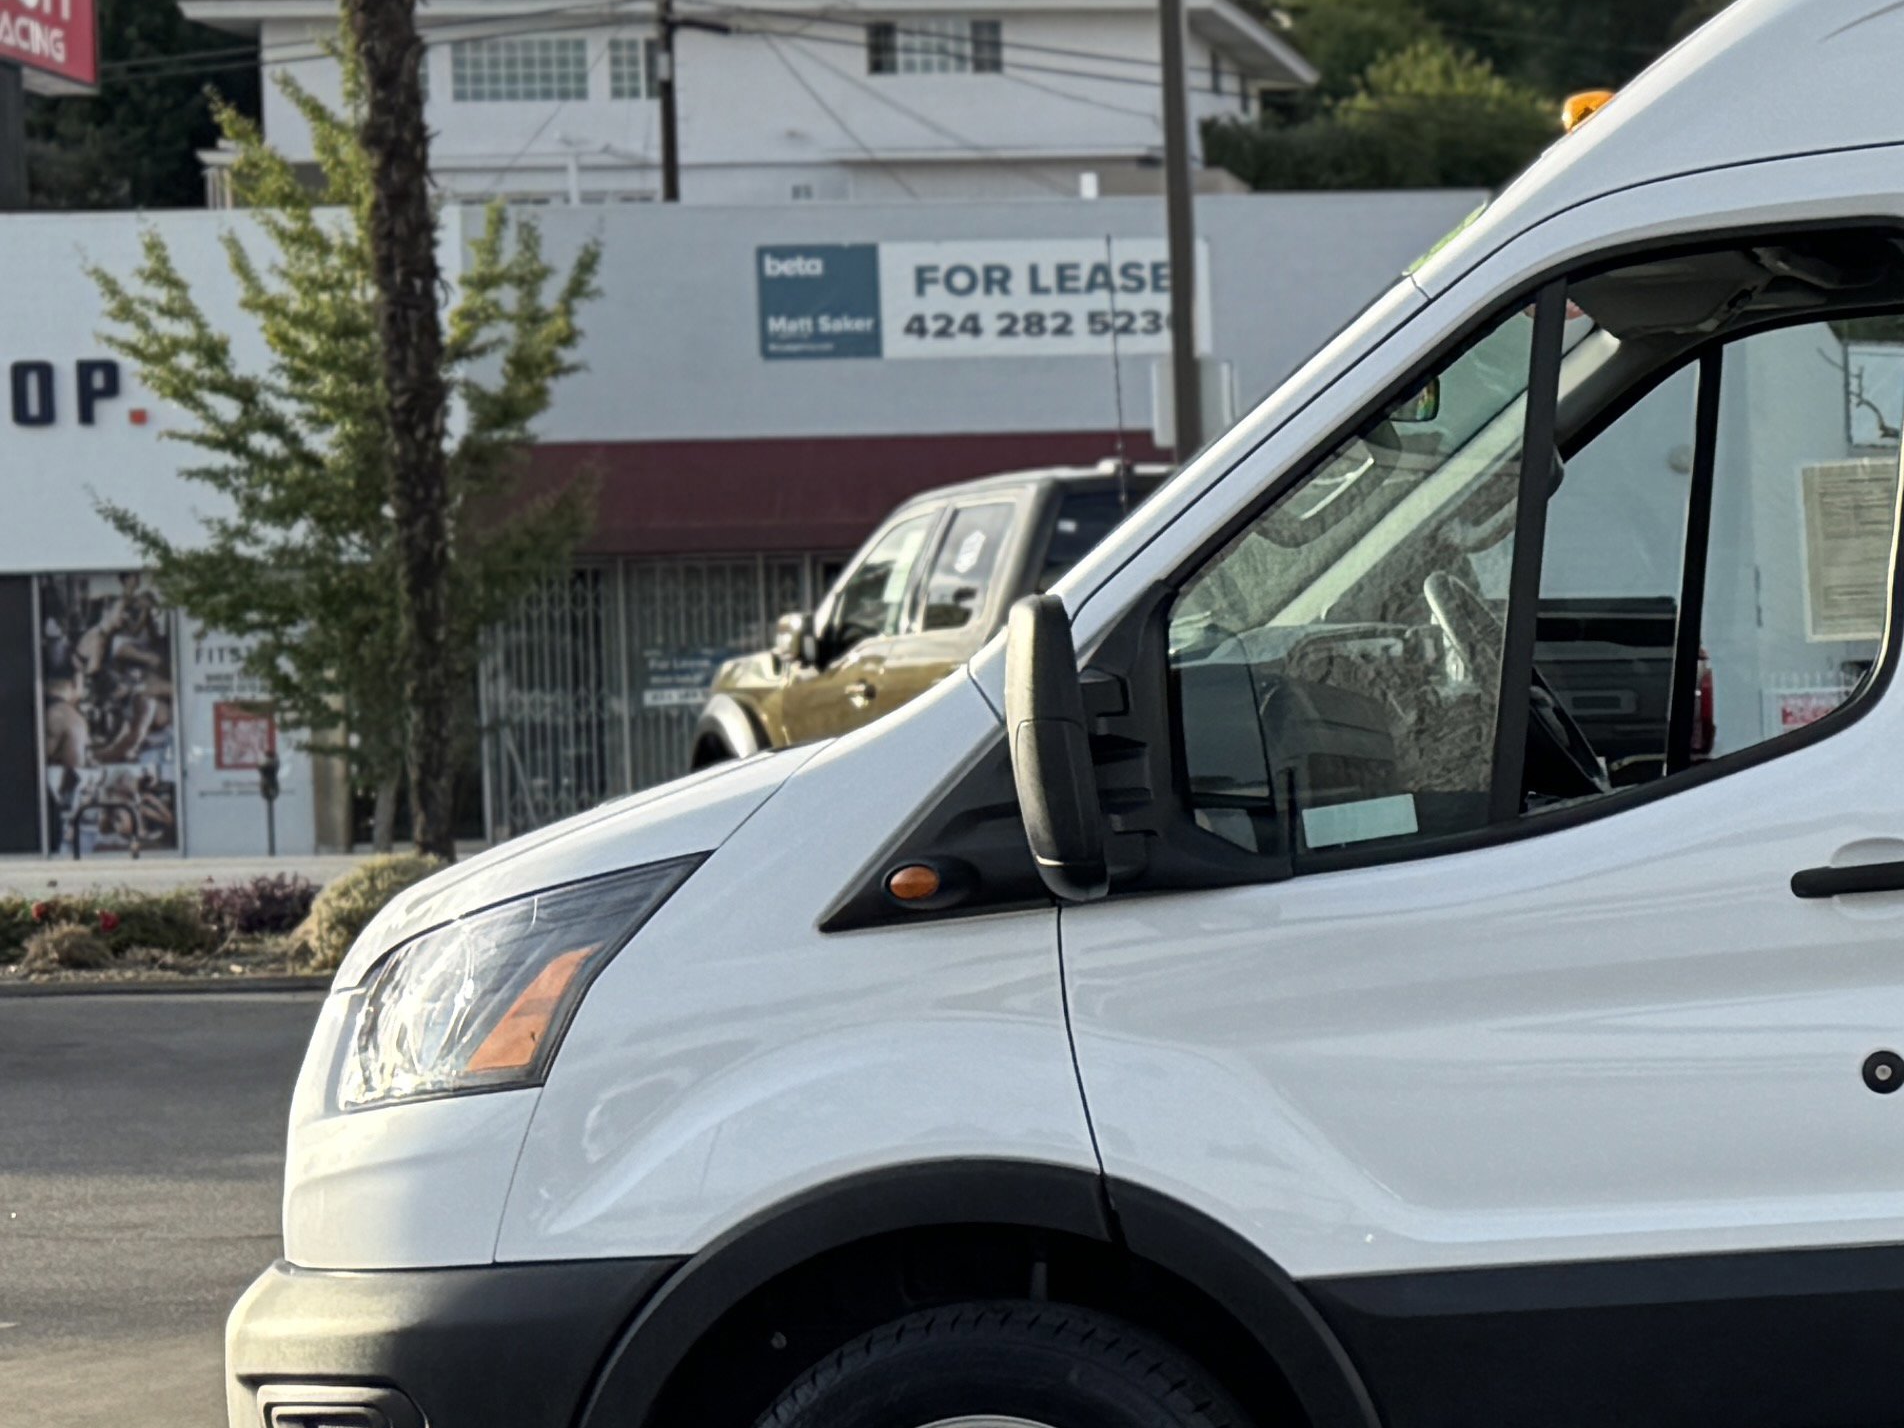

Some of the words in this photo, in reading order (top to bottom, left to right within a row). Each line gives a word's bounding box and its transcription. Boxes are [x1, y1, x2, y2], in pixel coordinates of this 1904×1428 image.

[764, 253, 824, 277] beta
[914, 264, 1012, 297] FOR
[1028, 261, 1172, 296] LEASE
[768, 315, 814, 333] Matt
[902, 312, 983, 339] 424
[996, 310, 1075, 338] 282
[1087, 308, 1172, 337] 523
